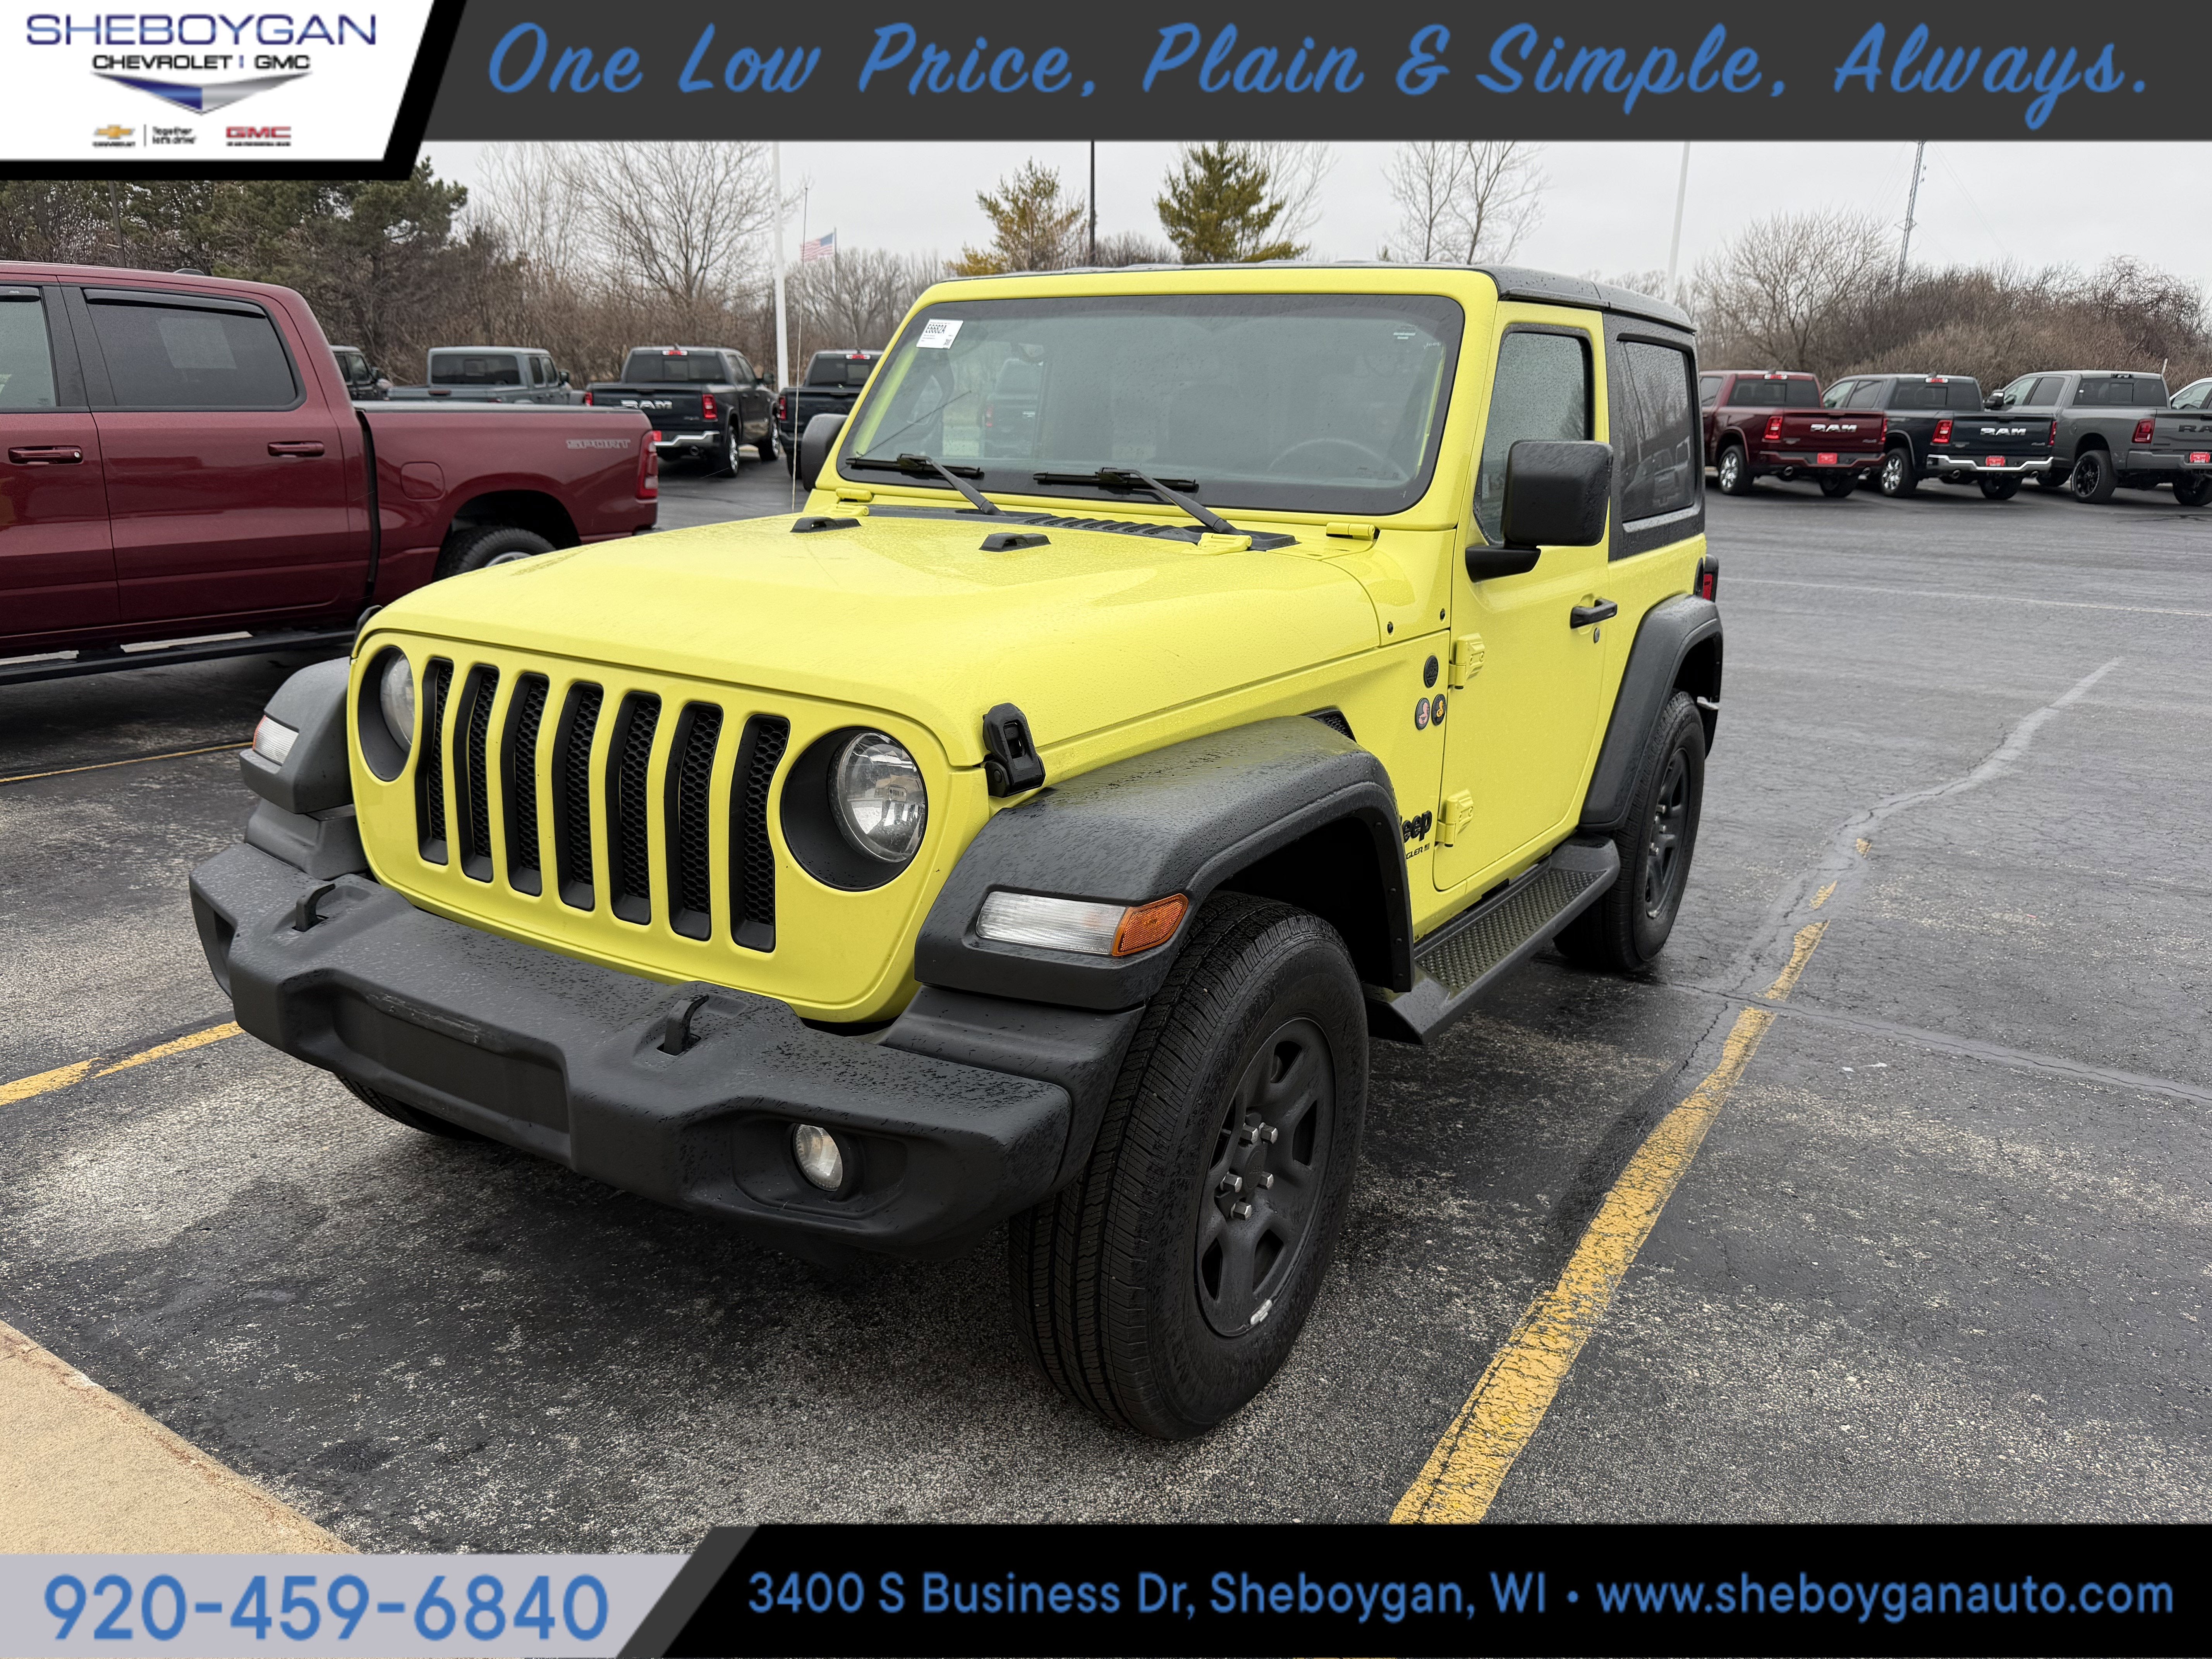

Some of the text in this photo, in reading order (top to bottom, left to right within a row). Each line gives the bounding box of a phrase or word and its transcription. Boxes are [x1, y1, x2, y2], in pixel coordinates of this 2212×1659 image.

[620, 400, 673, 410] RAM
[1810, 424, 1857, 432] RAM
[1980, 428, 2027, 436] RAM
[566, 439, 631, 449] SPORT
[1400, 810, 1432, 843] eep
[1406, 846, 1423, 860] GLER
